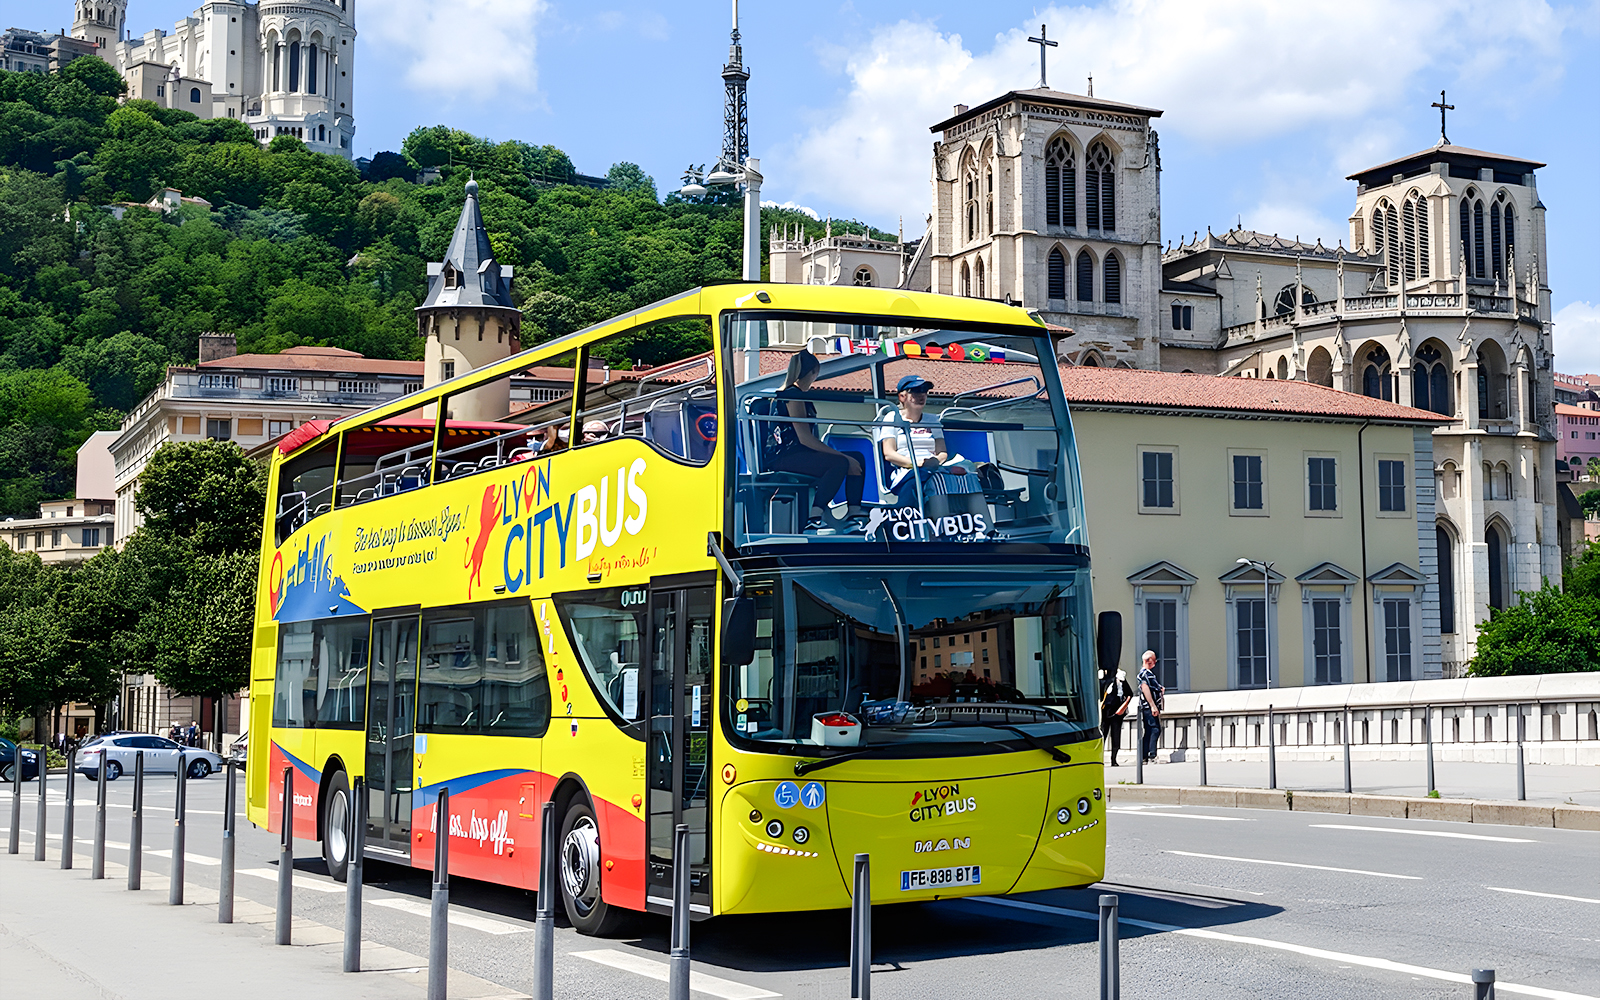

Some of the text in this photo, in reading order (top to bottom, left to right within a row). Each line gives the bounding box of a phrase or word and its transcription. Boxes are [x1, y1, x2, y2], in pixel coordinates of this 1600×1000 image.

[503, 459, 551, 526] LYON
[888, 507, 923, 522] LYON
[893, 513, 987, 541] CITYBUS
[924, 784, 960, 802] LYON
[909, 796, 977, 822] CITYBUS
[914, 837, 971, 853] MAN
